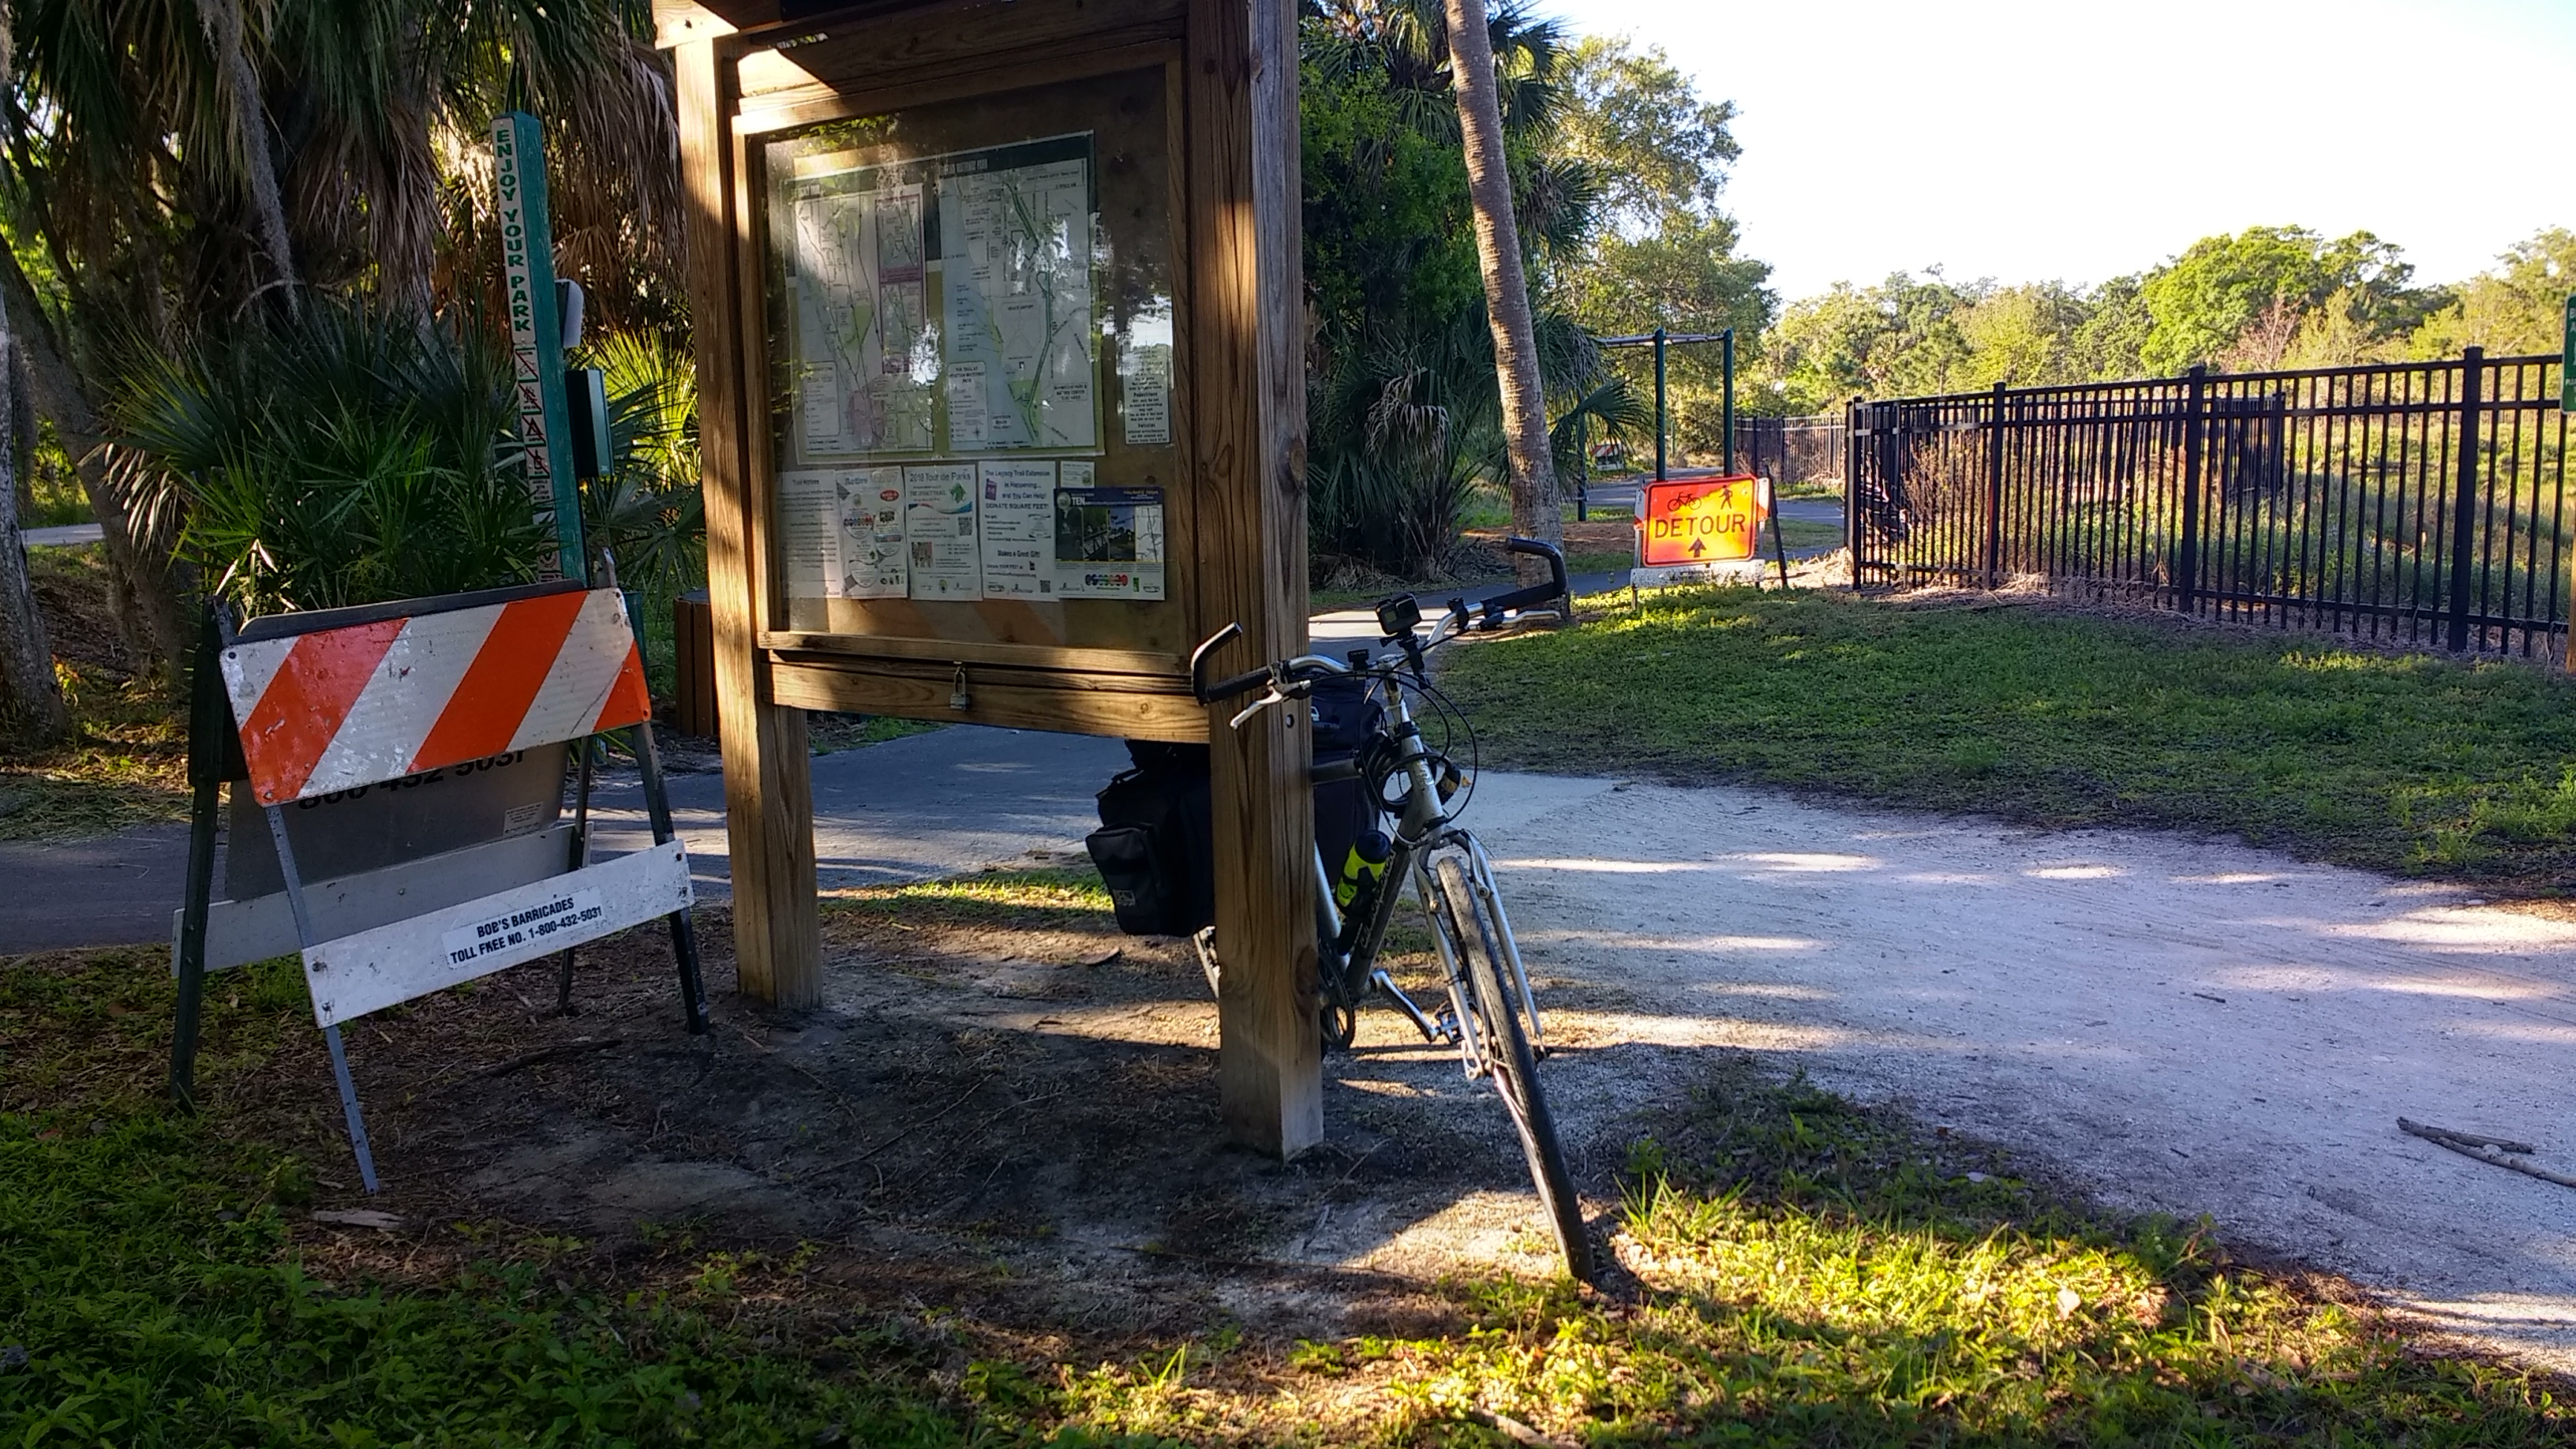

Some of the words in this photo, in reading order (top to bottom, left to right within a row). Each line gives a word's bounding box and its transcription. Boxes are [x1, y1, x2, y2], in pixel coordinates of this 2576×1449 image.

[496, 129, 516, 201] ENJOY
[504, 208, 524, 267] YOUR
[511, 275, 530, 331] PARK
[926, 472, 938, 481] Tour
[951, 472, 971, 481] Parks
[1072, 496, 1085, 506] TEN
[1654, 513, 1746, 539] DETOUR
[450, 949, 477, 964] TOLL
[507, 931, 526, 945] NO.
[528, 906, 603, 939] 1-800-432-5031
[477, 918, 510, 938] BOB'S
[511, 897, 575, 928] BARRICADES
